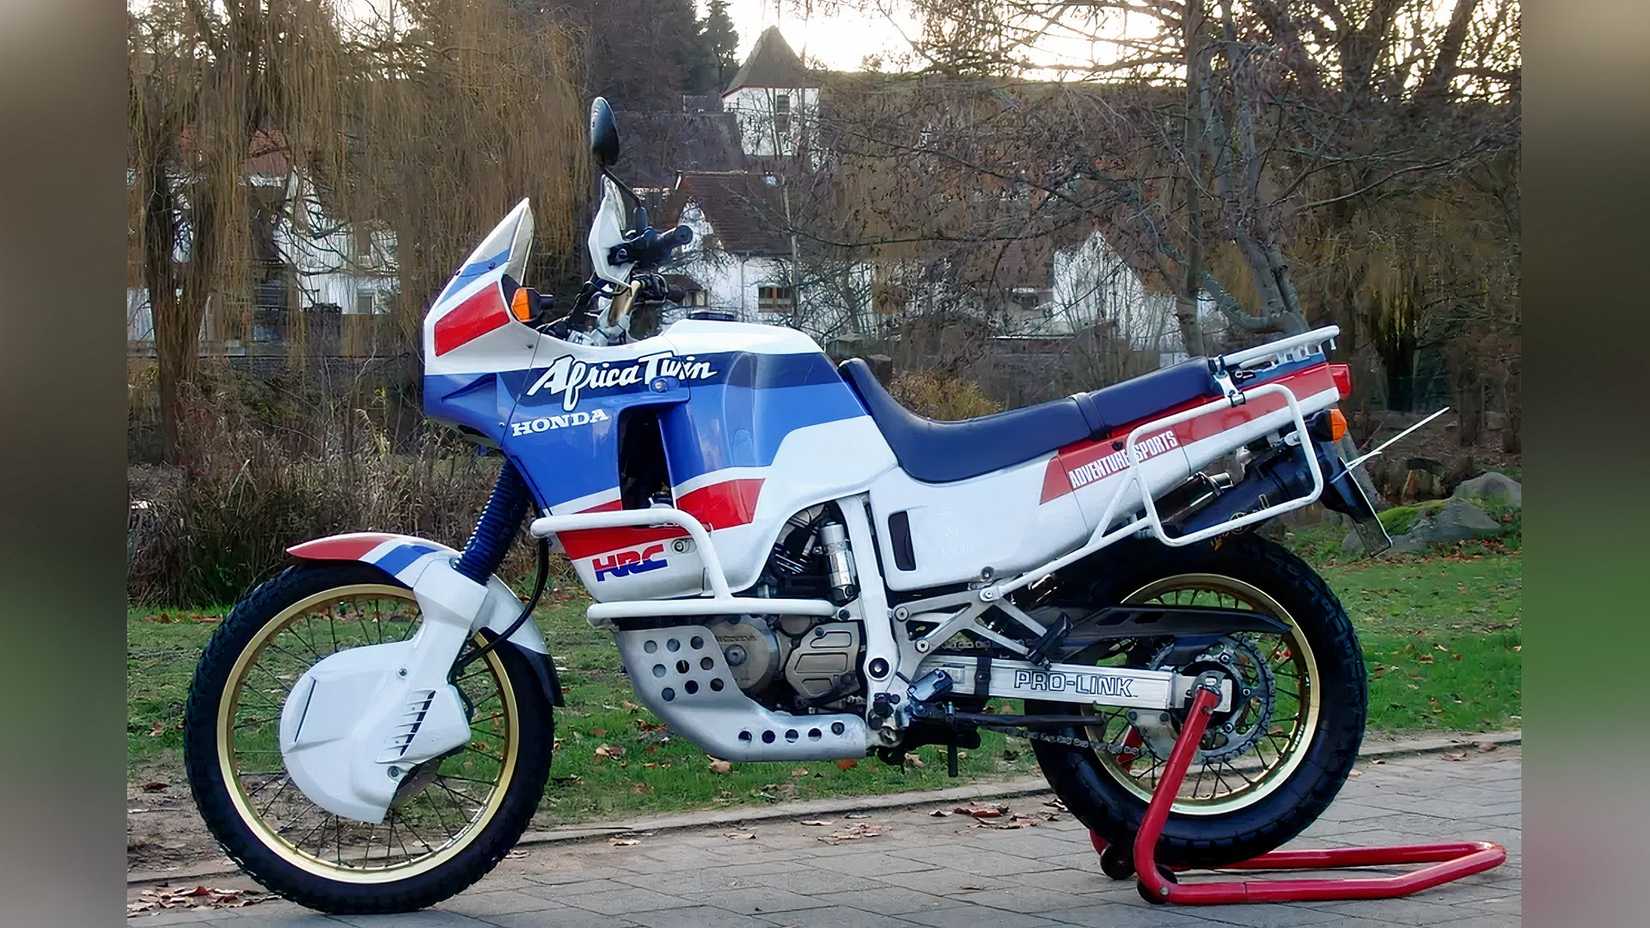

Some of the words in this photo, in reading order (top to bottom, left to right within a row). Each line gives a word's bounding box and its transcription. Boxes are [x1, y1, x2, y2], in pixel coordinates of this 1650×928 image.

[526, 355, 642, 411] Africa
[638, 351, 717, 384] Twin
[511, 408, 609, 437] HONDA
[1134, 430, 1178, 462] SPORTS
[591, 543, 669, 582] HRC
[1013, 669, 1135, 698] PRO-LINK
